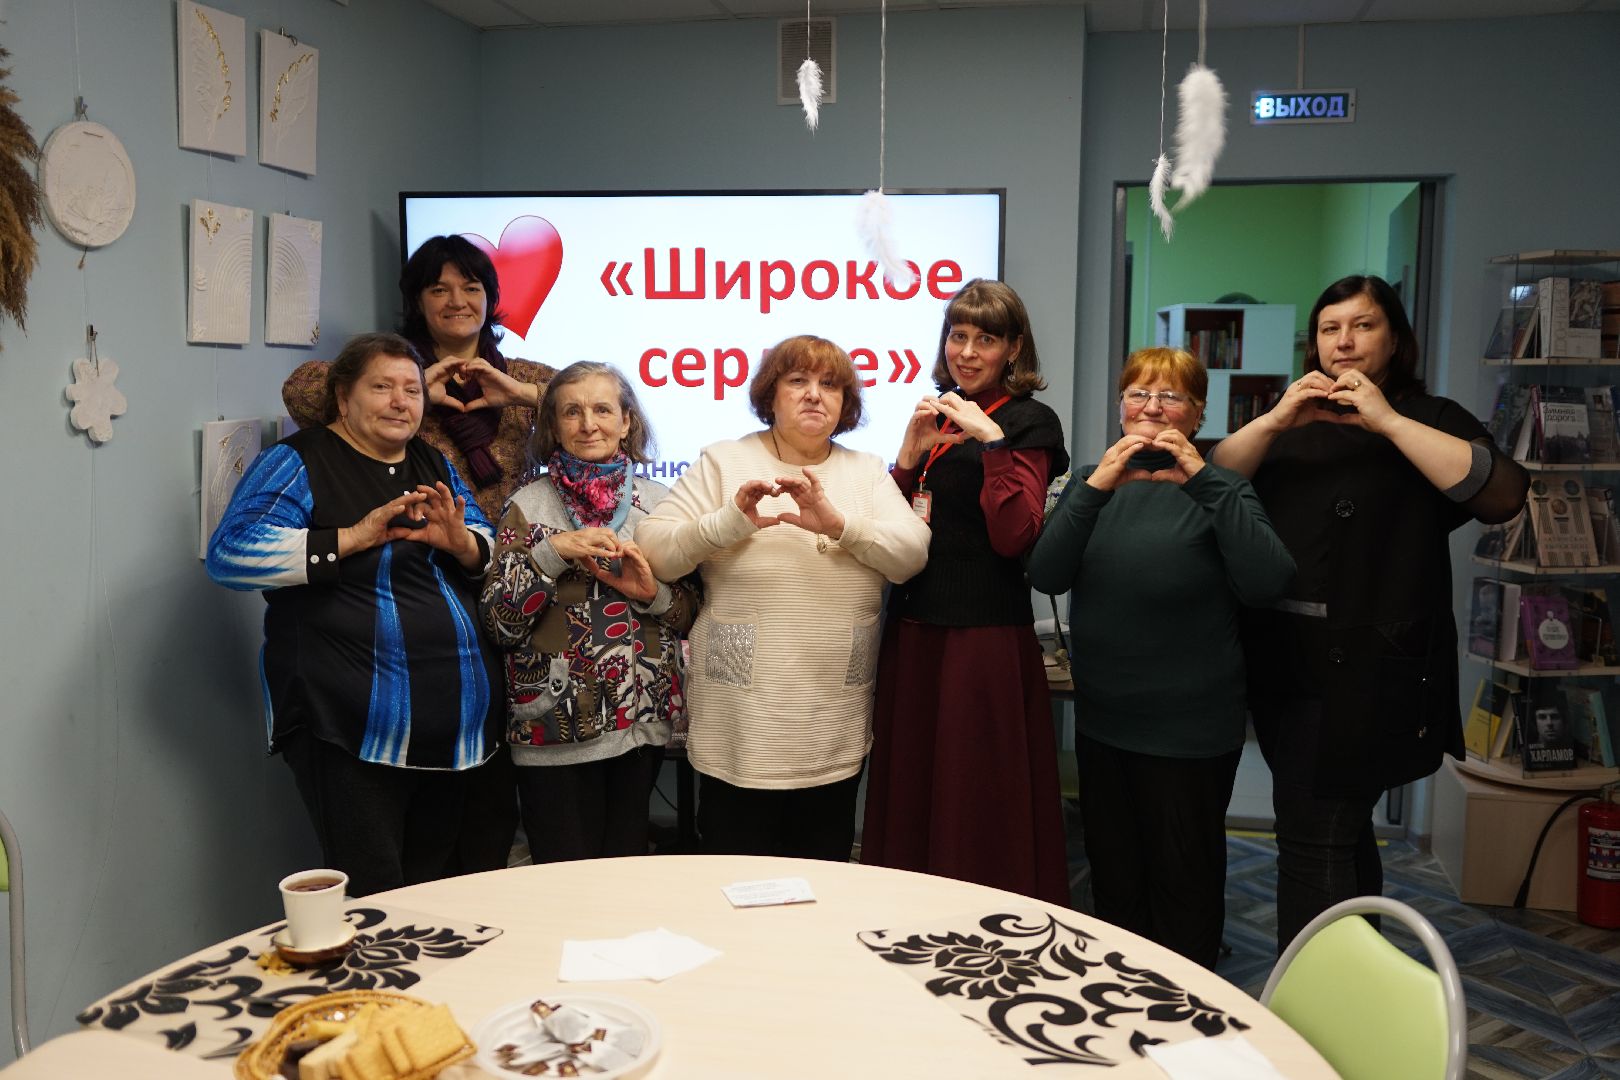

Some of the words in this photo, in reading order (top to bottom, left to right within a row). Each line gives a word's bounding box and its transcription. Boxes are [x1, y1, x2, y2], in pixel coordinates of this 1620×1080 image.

[1258, 96, 1345, 118] ВЫХОД
[600, 247, 962, 314] «Широкое
[639, 347, 922, 400] сере»
